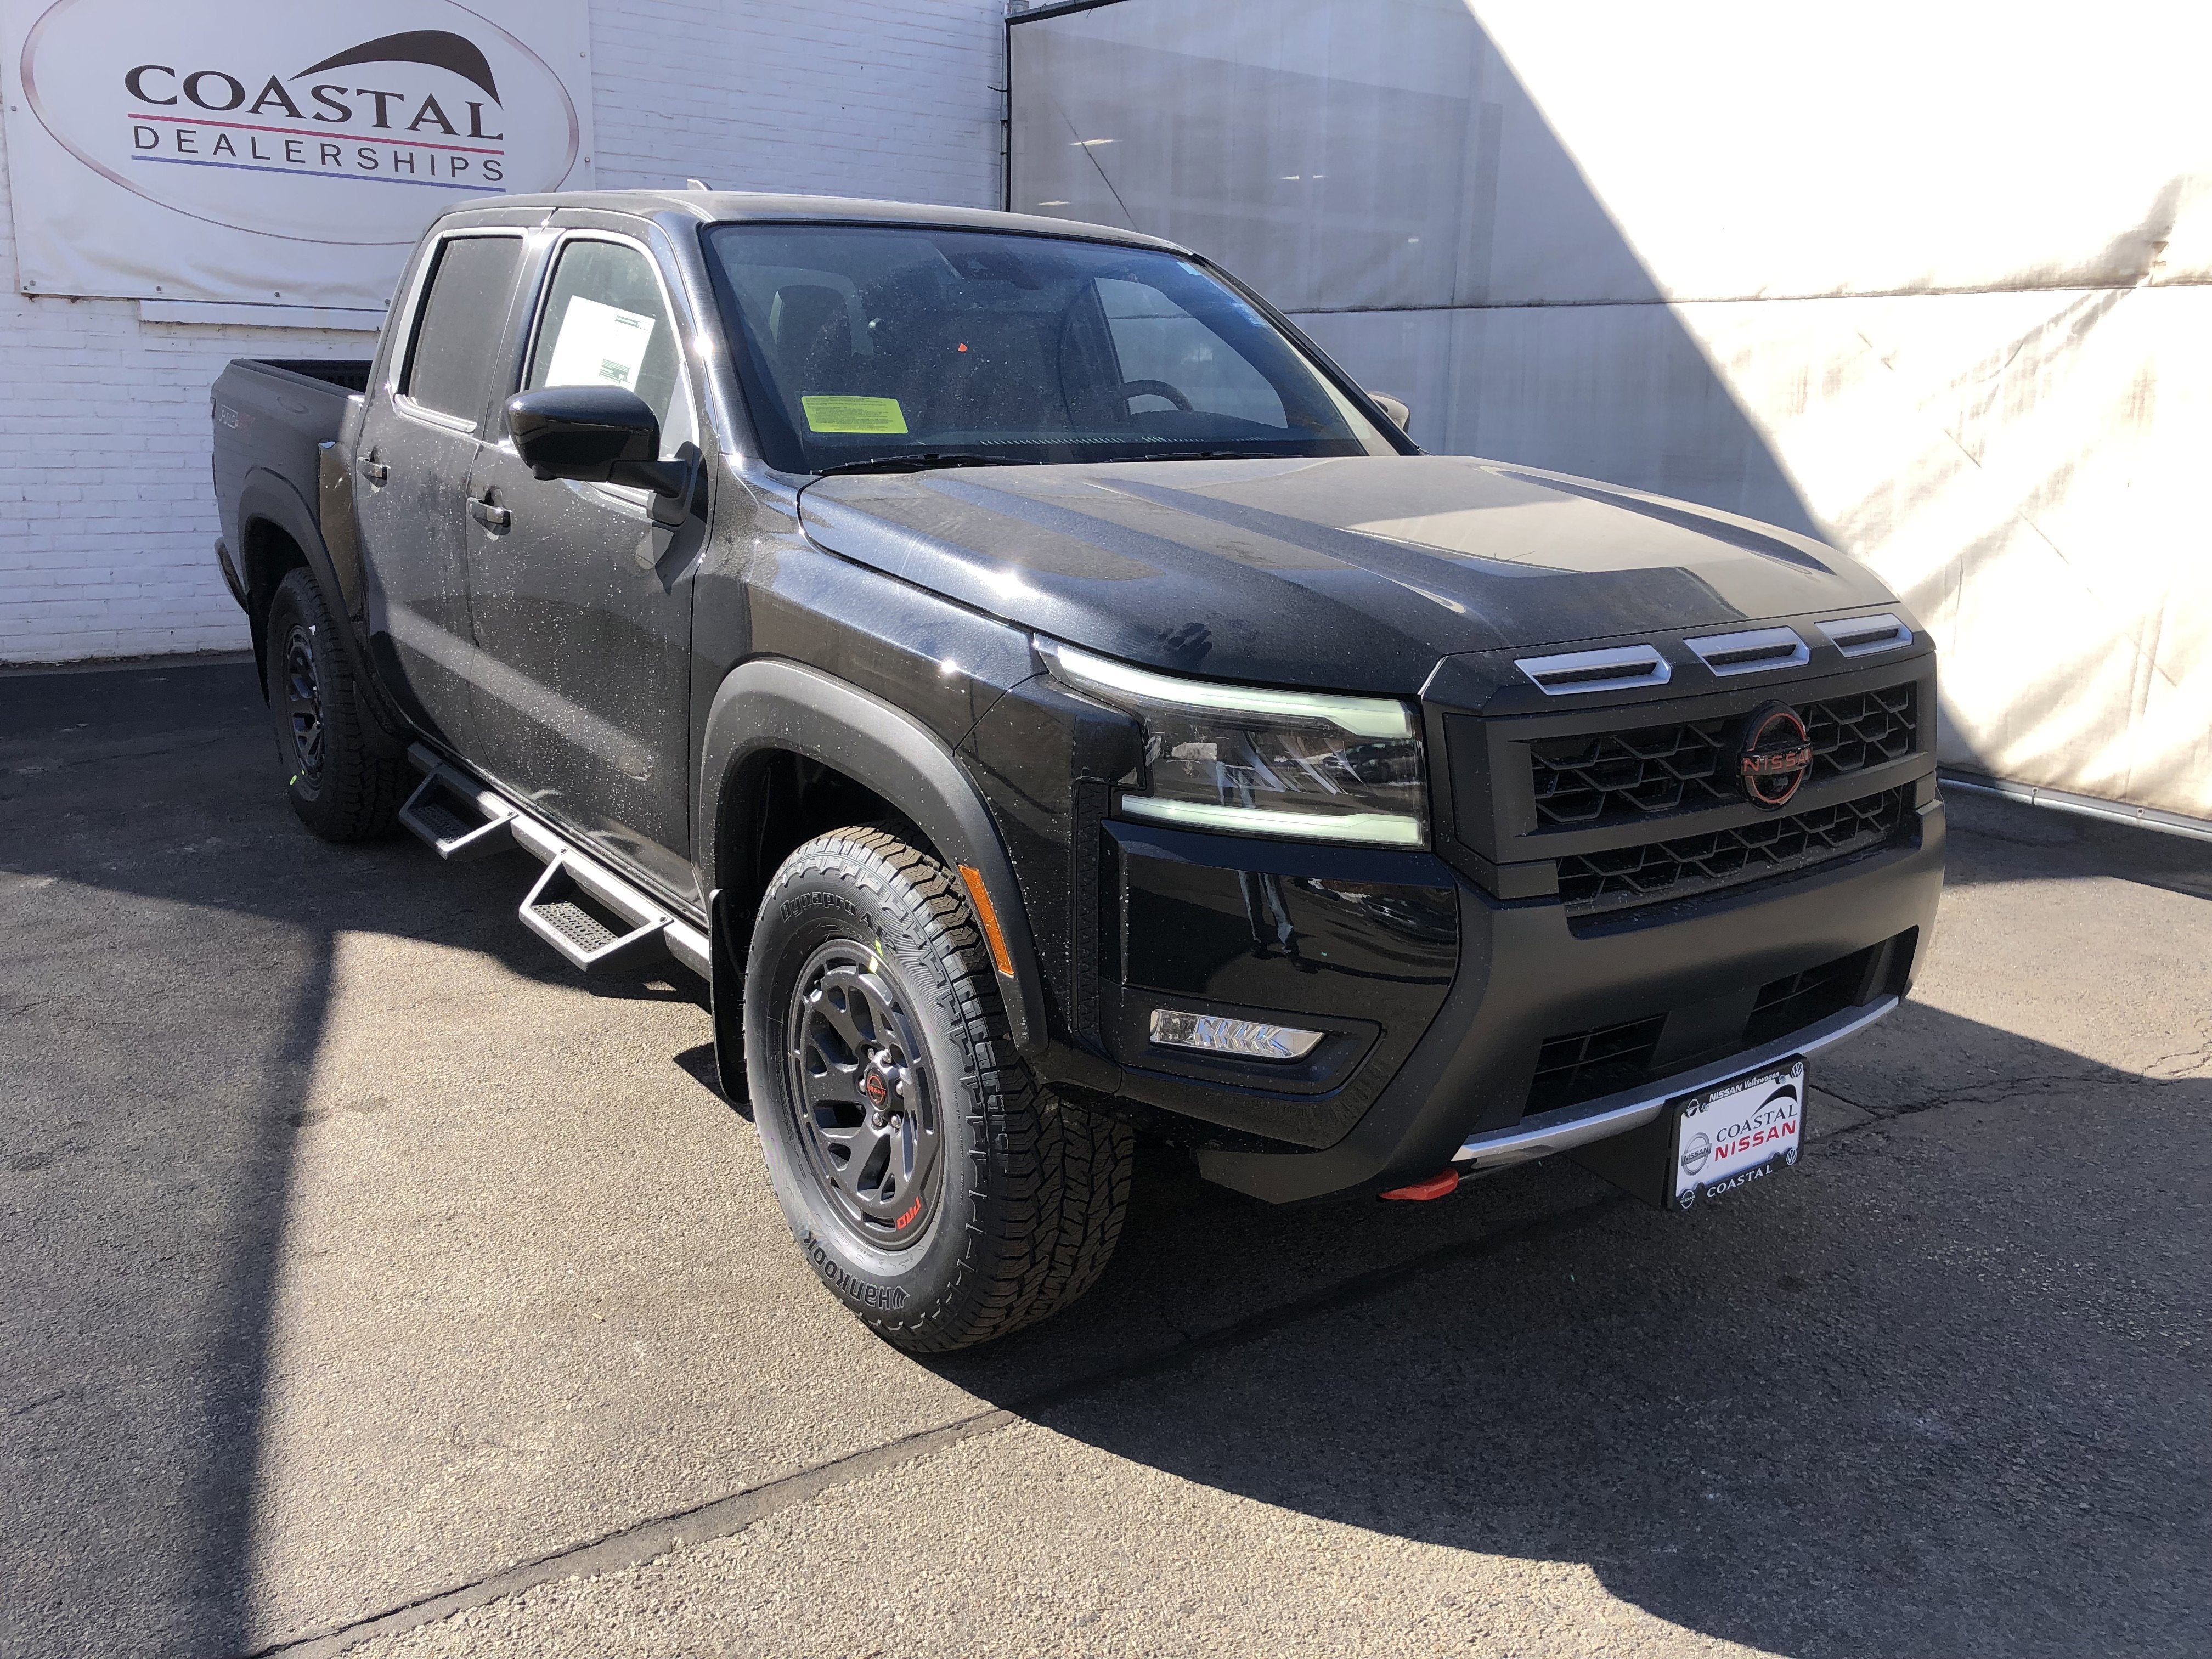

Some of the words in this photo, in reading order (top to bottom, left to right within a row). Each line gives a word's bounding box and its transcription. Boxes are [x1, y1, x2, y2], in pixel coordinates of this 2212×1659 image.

[125, 64, 504, 140] COASTAL
[133, 125, 504, 182] DEALERSHIPS
[1743, 747, 1813, 772] NISSAN
[780, 891, 856, 923] Dynapro
[1709, 1083, 1742, 1102] NISSAN
[1744, 1071, 1780, 1089] Volkswagen
[1716, 1104, 1797, 1142] COASTAL
[1684, 1146, 1709, 1162] NISSAN
[1714, 1119, 1796, 1161] NISSAN
[1707, 1164, 1773, 1197] COASTAL
[896, 1195, 921, 1229] PRO
